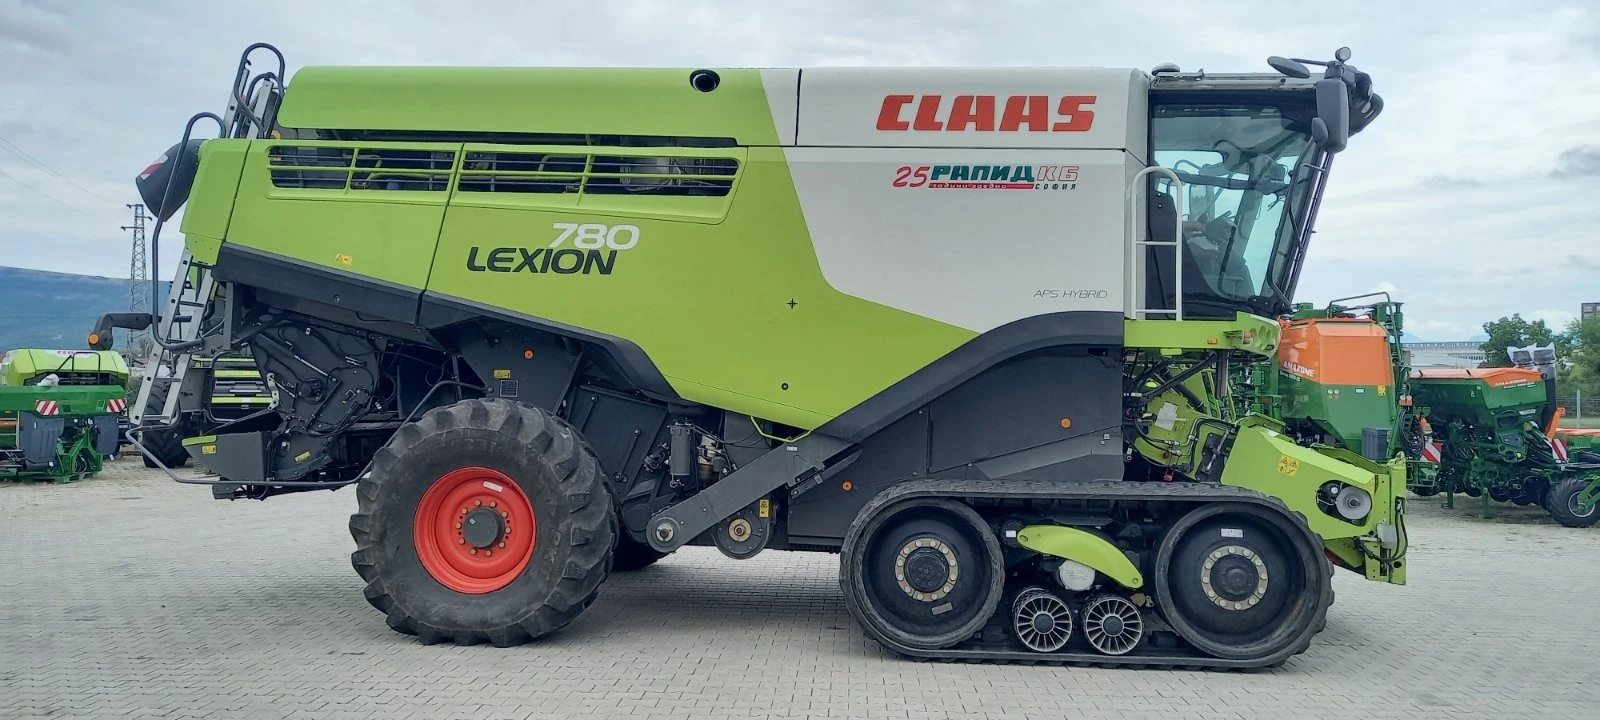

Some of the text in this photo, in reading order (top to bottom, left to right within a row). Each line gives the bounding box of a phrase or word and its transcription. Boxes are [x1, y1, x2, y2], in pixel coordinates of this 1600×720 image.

[876, 94, 1097, 132] CLAAS
[892, 165, 1080, 188] 25 РАПИД КБ
[549, 222, 640, 251] 780
[466, 246, 617, 275] LEXION
[1033, 289, 1108, 299] APS HYBRID
[1282, 360, 1316, 378] AMAZONE
